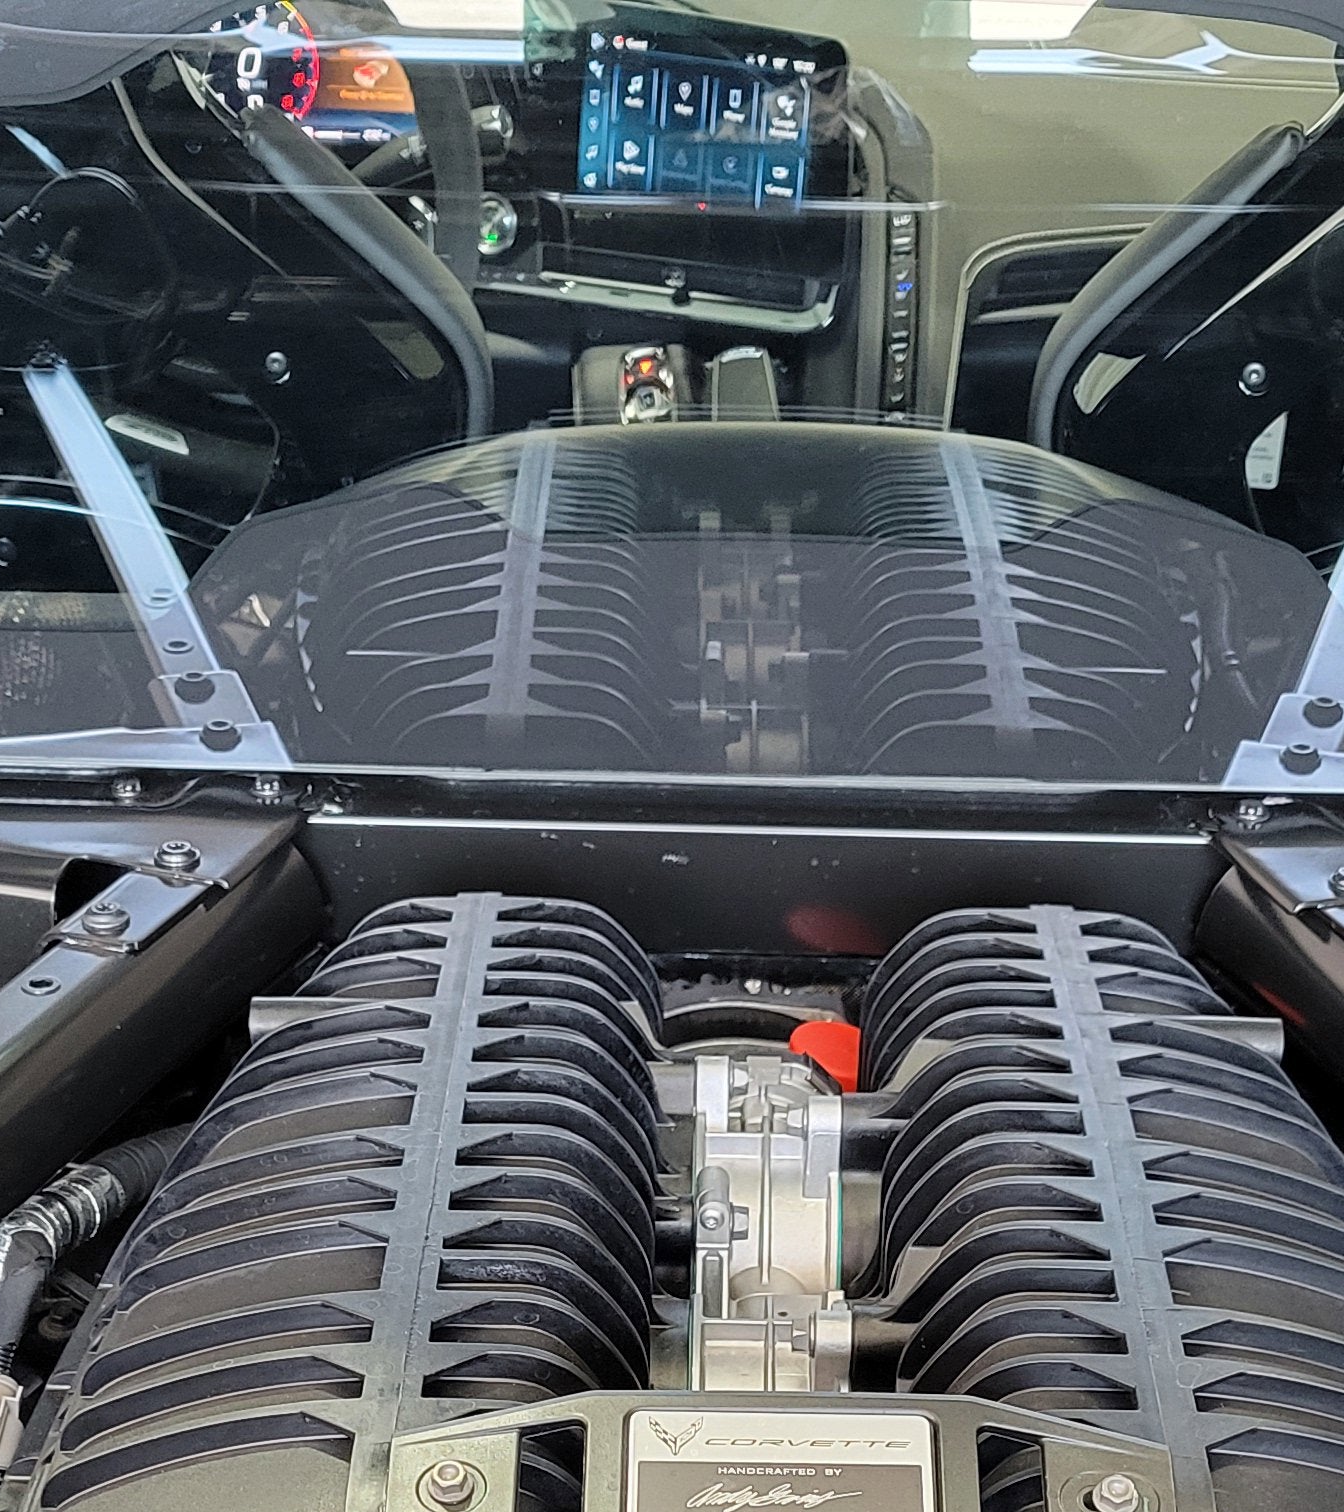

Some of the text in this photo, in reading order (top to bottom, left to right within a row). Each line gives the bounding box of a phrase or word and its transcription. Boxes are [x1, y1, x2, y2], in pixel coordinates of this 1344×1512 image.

[236, 47, 262, 79] 0
[704, 1438, 911, 1449] CORVETTE
[717, 1466, 843, 1477] HANDCRAFTED BY
